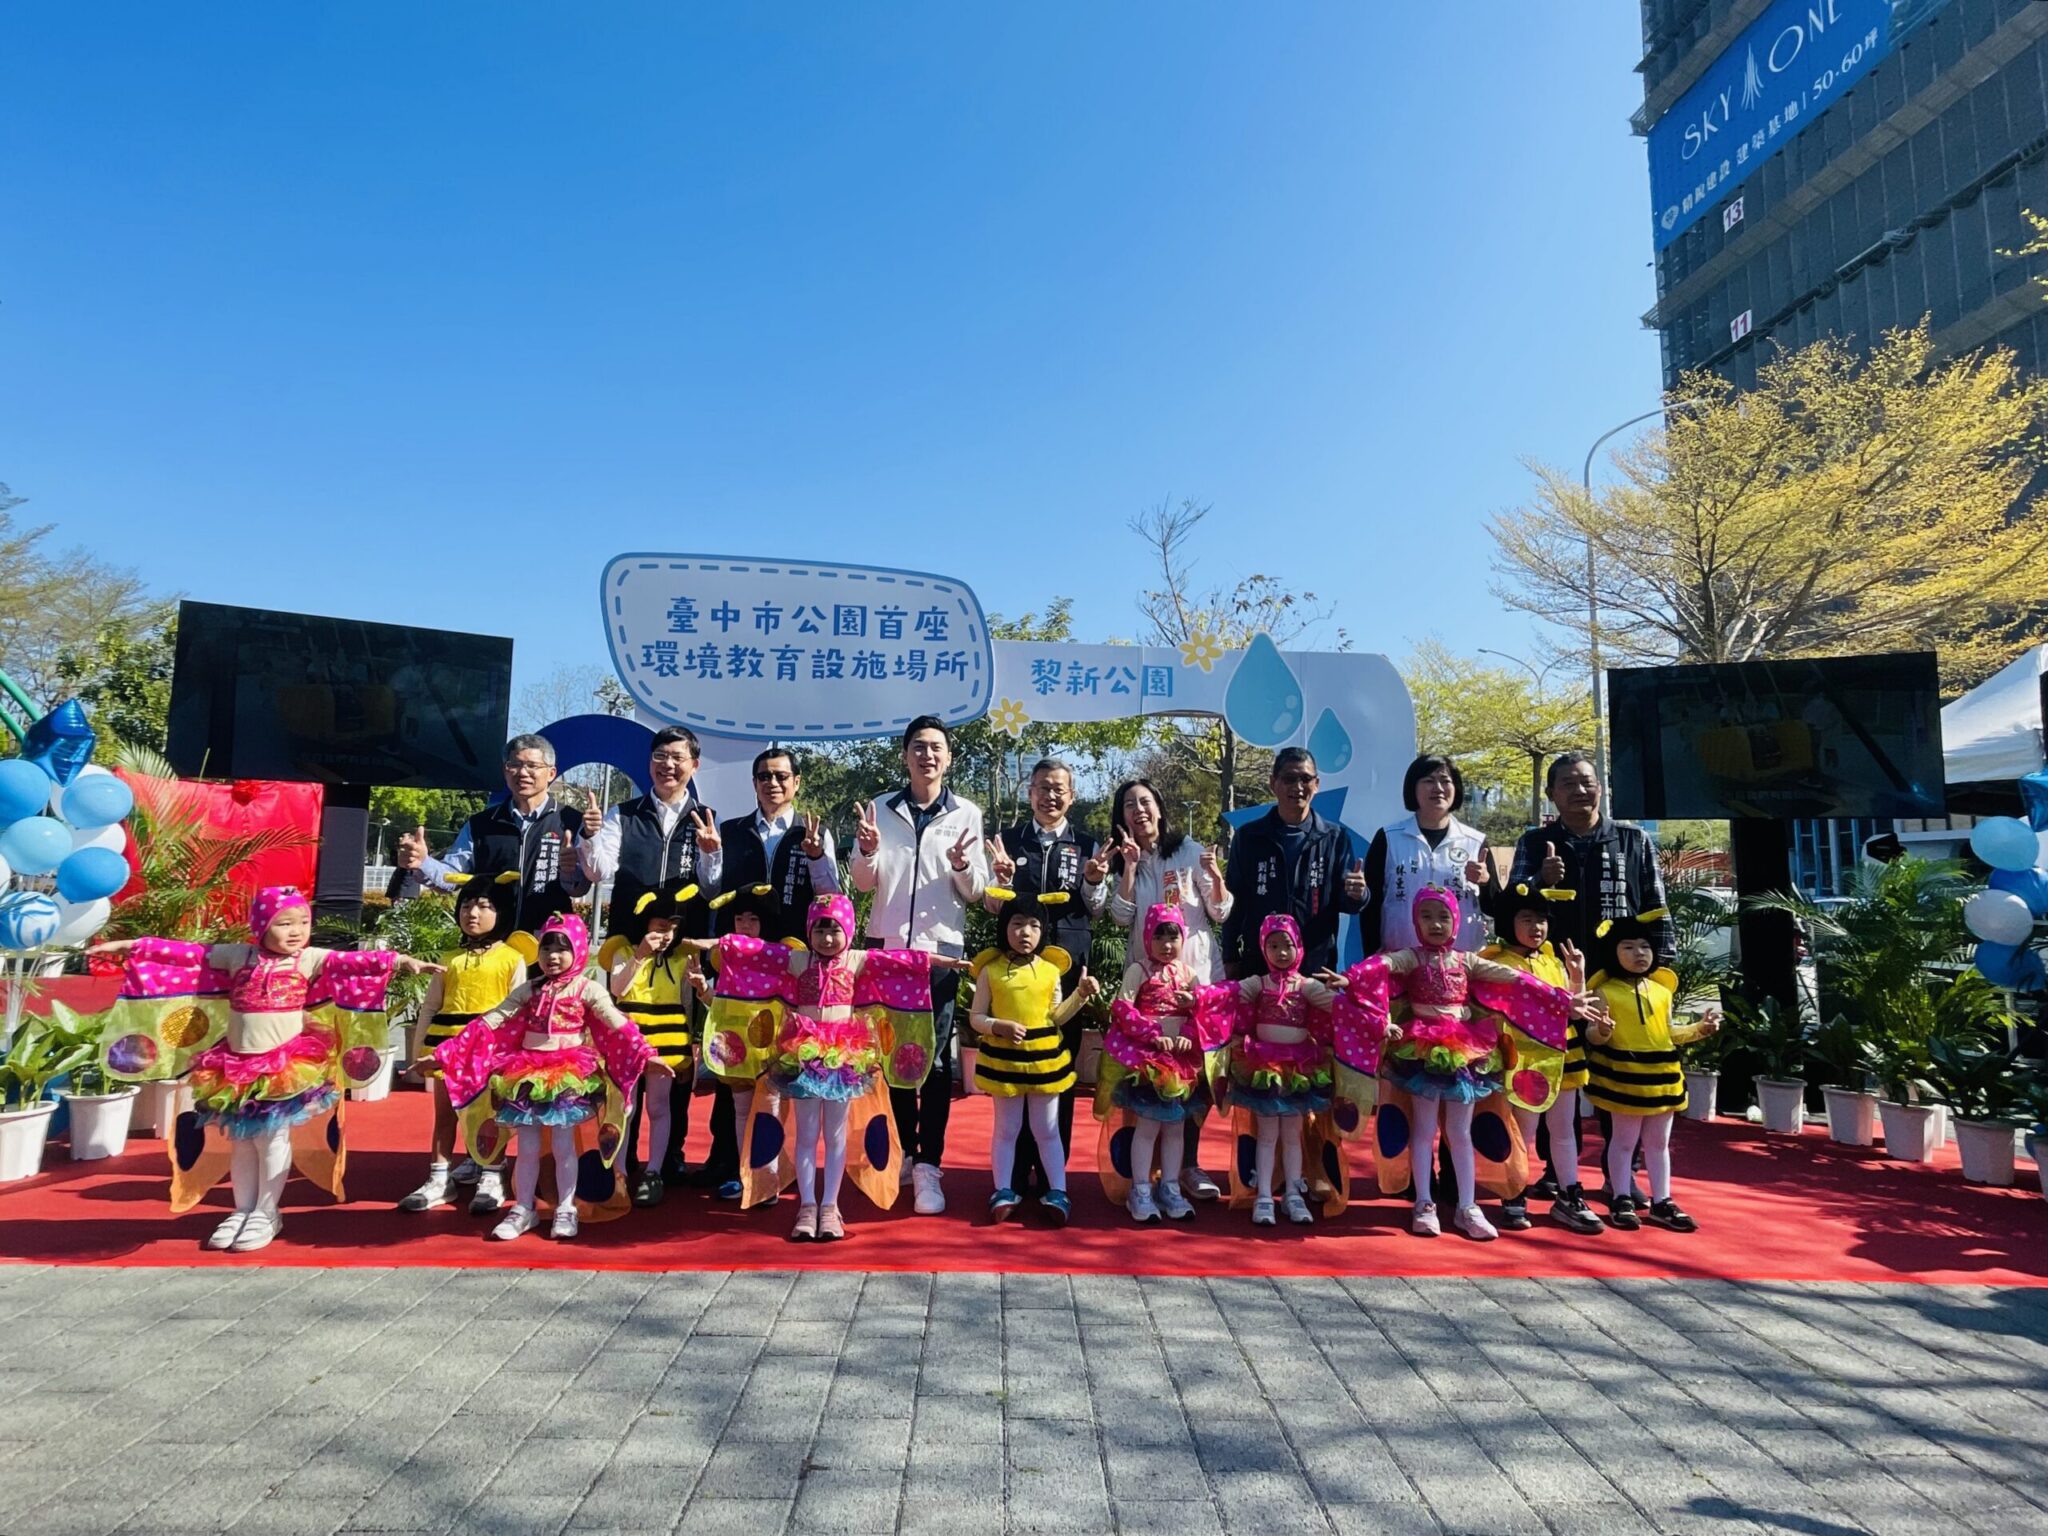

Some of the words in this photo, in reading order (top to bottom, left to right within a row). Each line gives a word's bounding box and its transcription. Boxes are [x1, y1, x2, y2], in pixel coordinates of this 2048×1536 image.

[1681, 85, 1731, 160] SKY
[1768, 0, 1843, 73] ONE
[1725, 200, 1742, 229] 13
[1732, 312, 1749, 340] 11
[667, 596, 950, 642] 臺中市公園首座
[641, 639, 969, 683] 環境教育設施場所
[1031, 658, 1174, 698] 黎新公園
[1600, 880, 1613, 920] 劉士州
